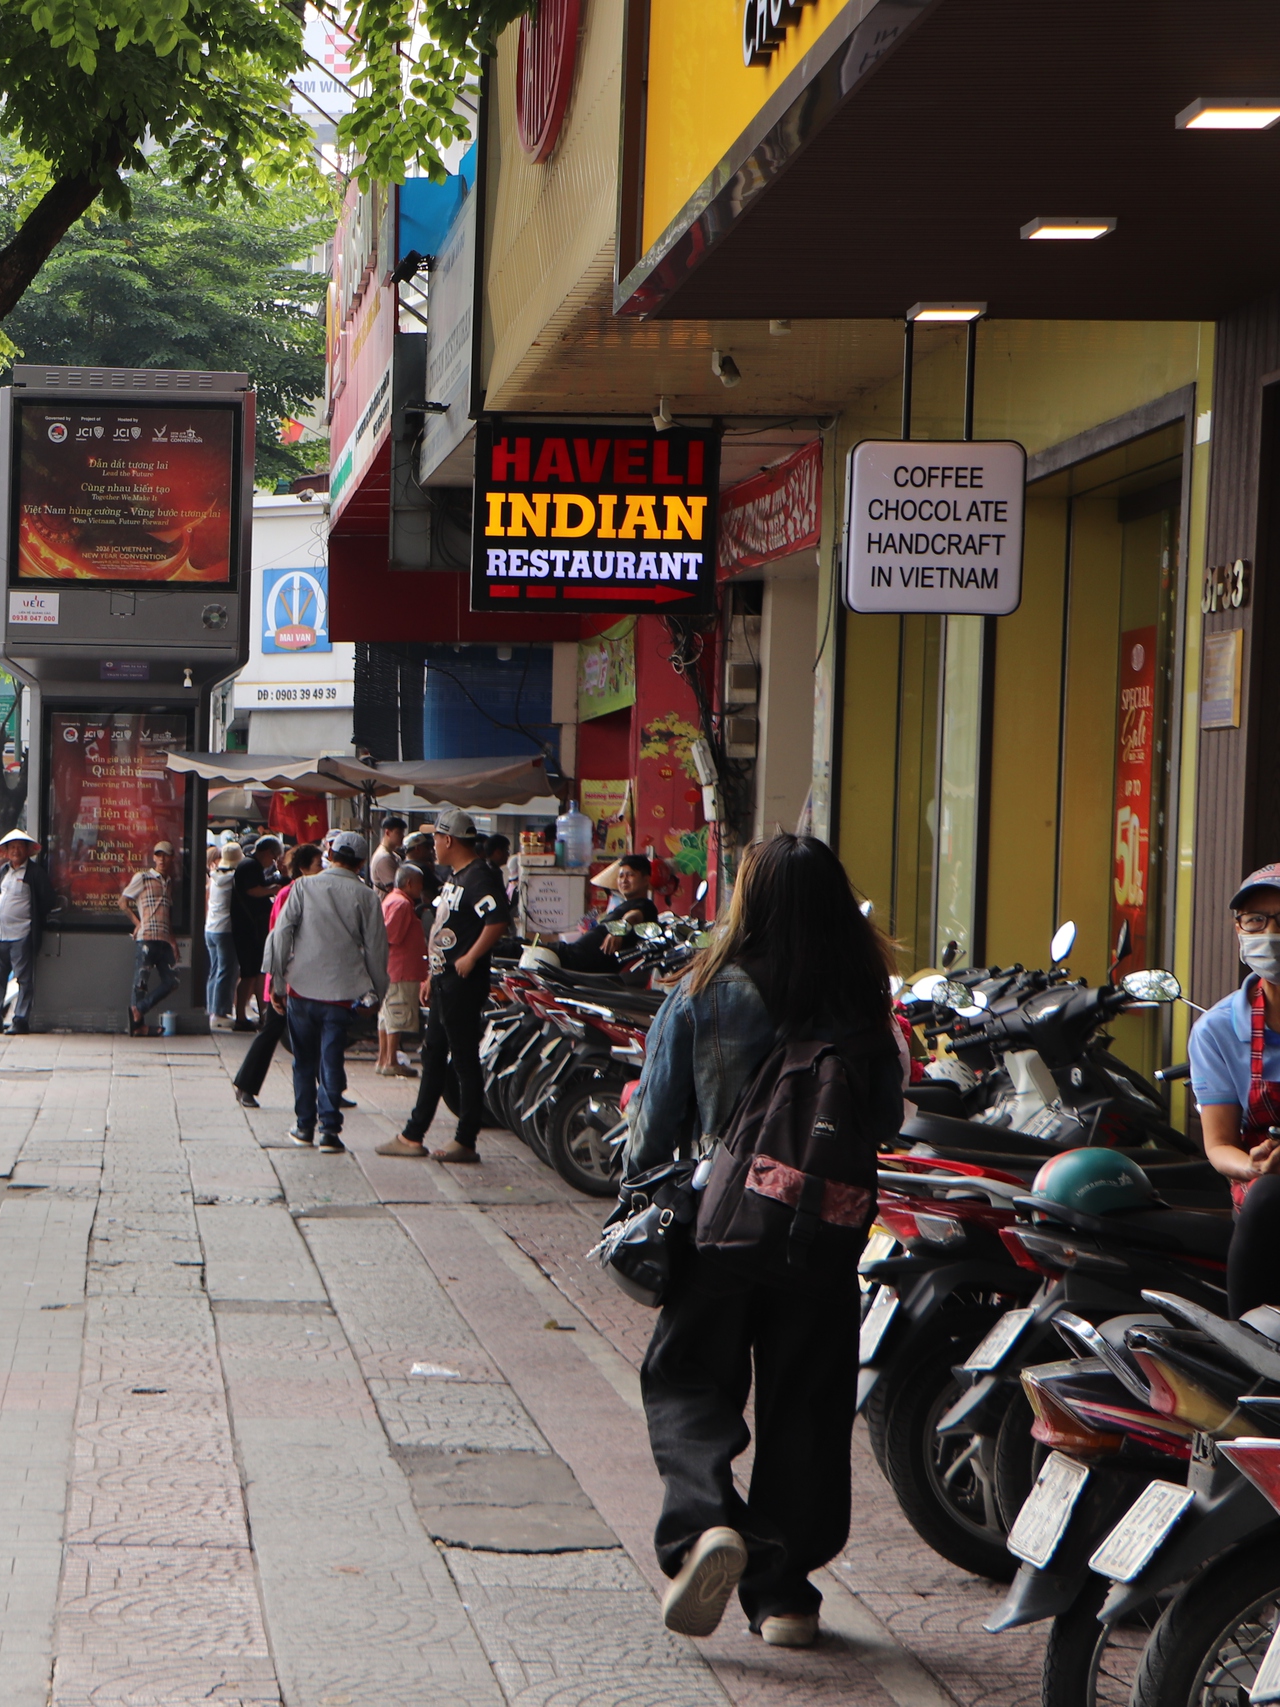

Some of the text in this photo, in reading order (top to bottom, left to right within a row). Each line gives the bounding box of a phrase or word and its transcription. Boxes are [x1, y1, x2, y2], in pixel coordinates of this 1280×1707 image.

[76, 428, 92, 437] JCI
[113, 428, 129, 438] JCI
[128, 461, 154, 470] tương
[157, 461, 168, 470] lai
[491, 437, 705, 485] HAVELI
[894, 466, 984, 488] COFFEE
[81, 483, 170, 494] Cùng nhau kiến tạo
[24, 505, 42, 515] Việt
[44, 505, 66, 514] Nam
[69, 506, 92, 516] hùng
[94, 506, 121, 517] cường
[131, 507, 155, 518] Vững
[158, 508, 178, 517] bước
[209, 509, 221, 518] lai
[484, 492, 708, 541] INDIAN
[868, 498, 1008, 522] CHOCOLATE
[868, 532, 1006, 556] HANDCRAFT
[486, 548, 703, 581] RESTAURANT
[871, 566, 998, 589] IN VIETNAM
[280, 634, 311, 642] MAI VAN
[276, 689, 298, 701] 0903
[300, 688, 310, 699] 39
[312, 688, 324, 699] 49
[326, 688, 337, 699] 39
[1122, 685, 1152, 711] SPECIAL
[92, 765, 116, 778] Quá
[82, 780, 120, 789] Preserving
[1124, 779, 1141, 797] UP TO
[93, 808, 139, 820] Hiện tại
[73, 823, 115, 831] Challenging
[88, 850, 142, 861] Tương lai
